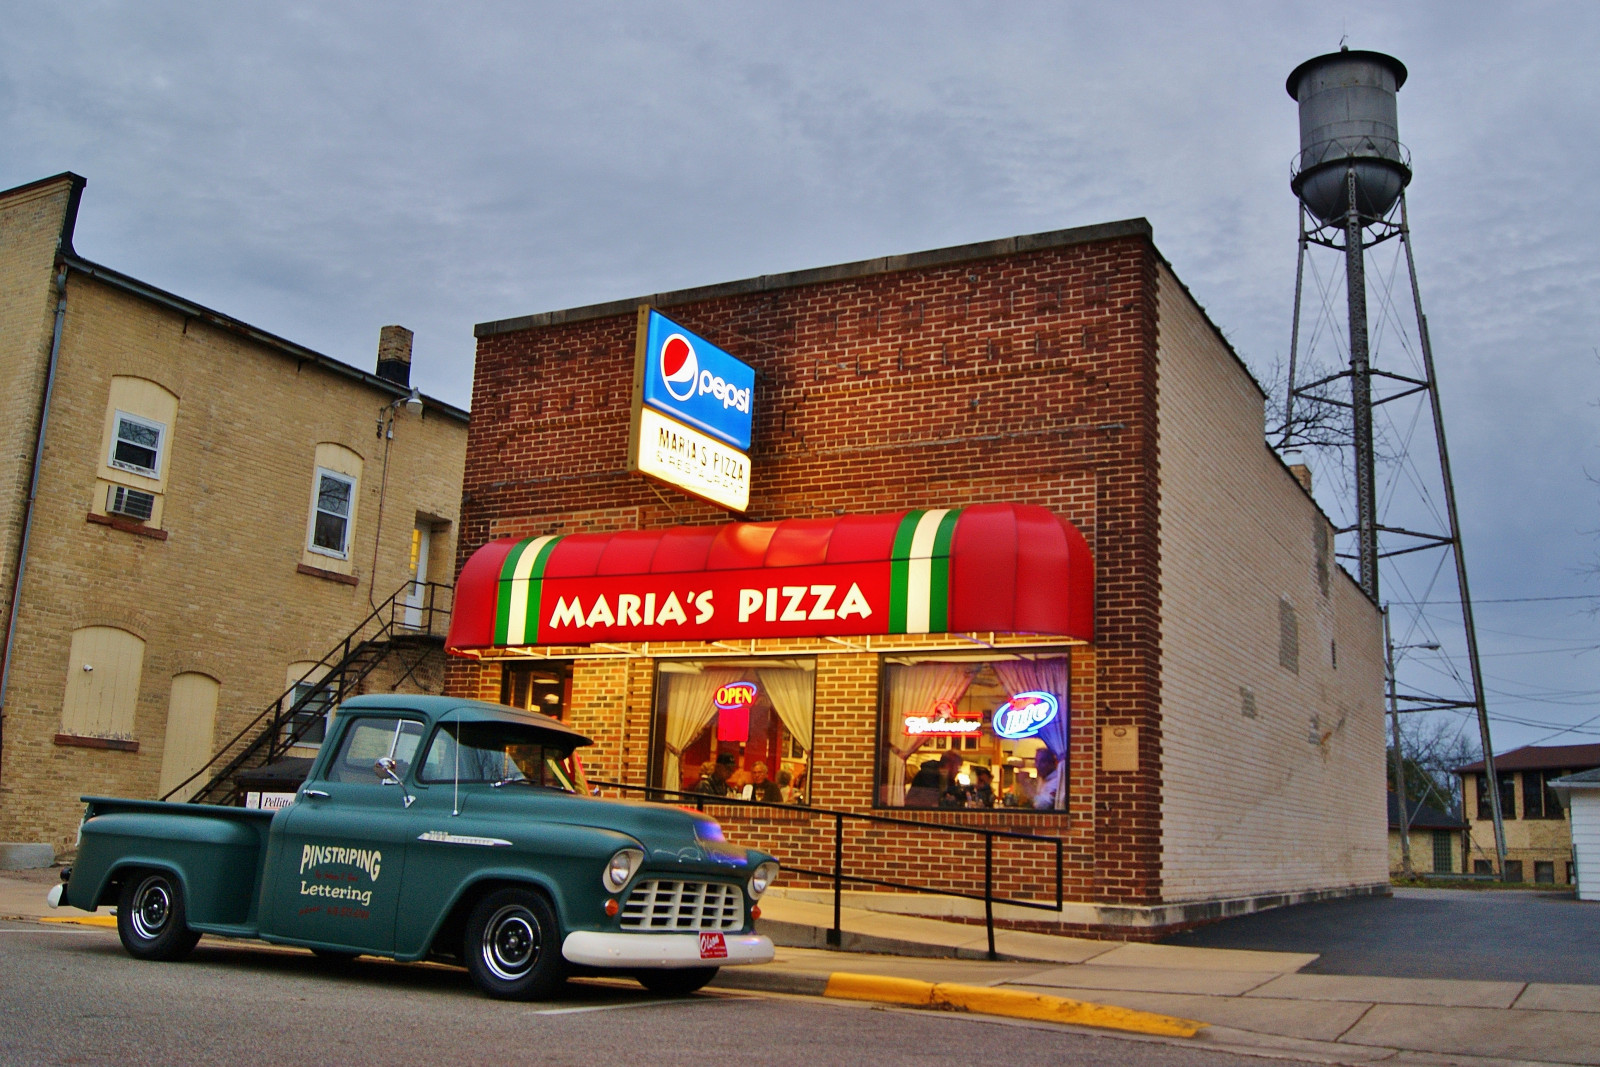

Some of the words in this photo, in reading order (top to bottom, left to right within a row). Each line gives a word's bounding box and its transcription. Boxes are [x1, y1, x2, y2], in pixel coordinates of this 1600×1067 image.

[698, 369, 750, 415] pepsi
[713, 452, 744, 480] PIZZA
[549, 590, 714, 629] MARIA'S
[738, 582, 873, 623] PIZZA
[716, 687, 753, 705] OPEN
[300, 844, 382, 882] PINSTRIPING
[300, 880, 373, 907] Lettering
